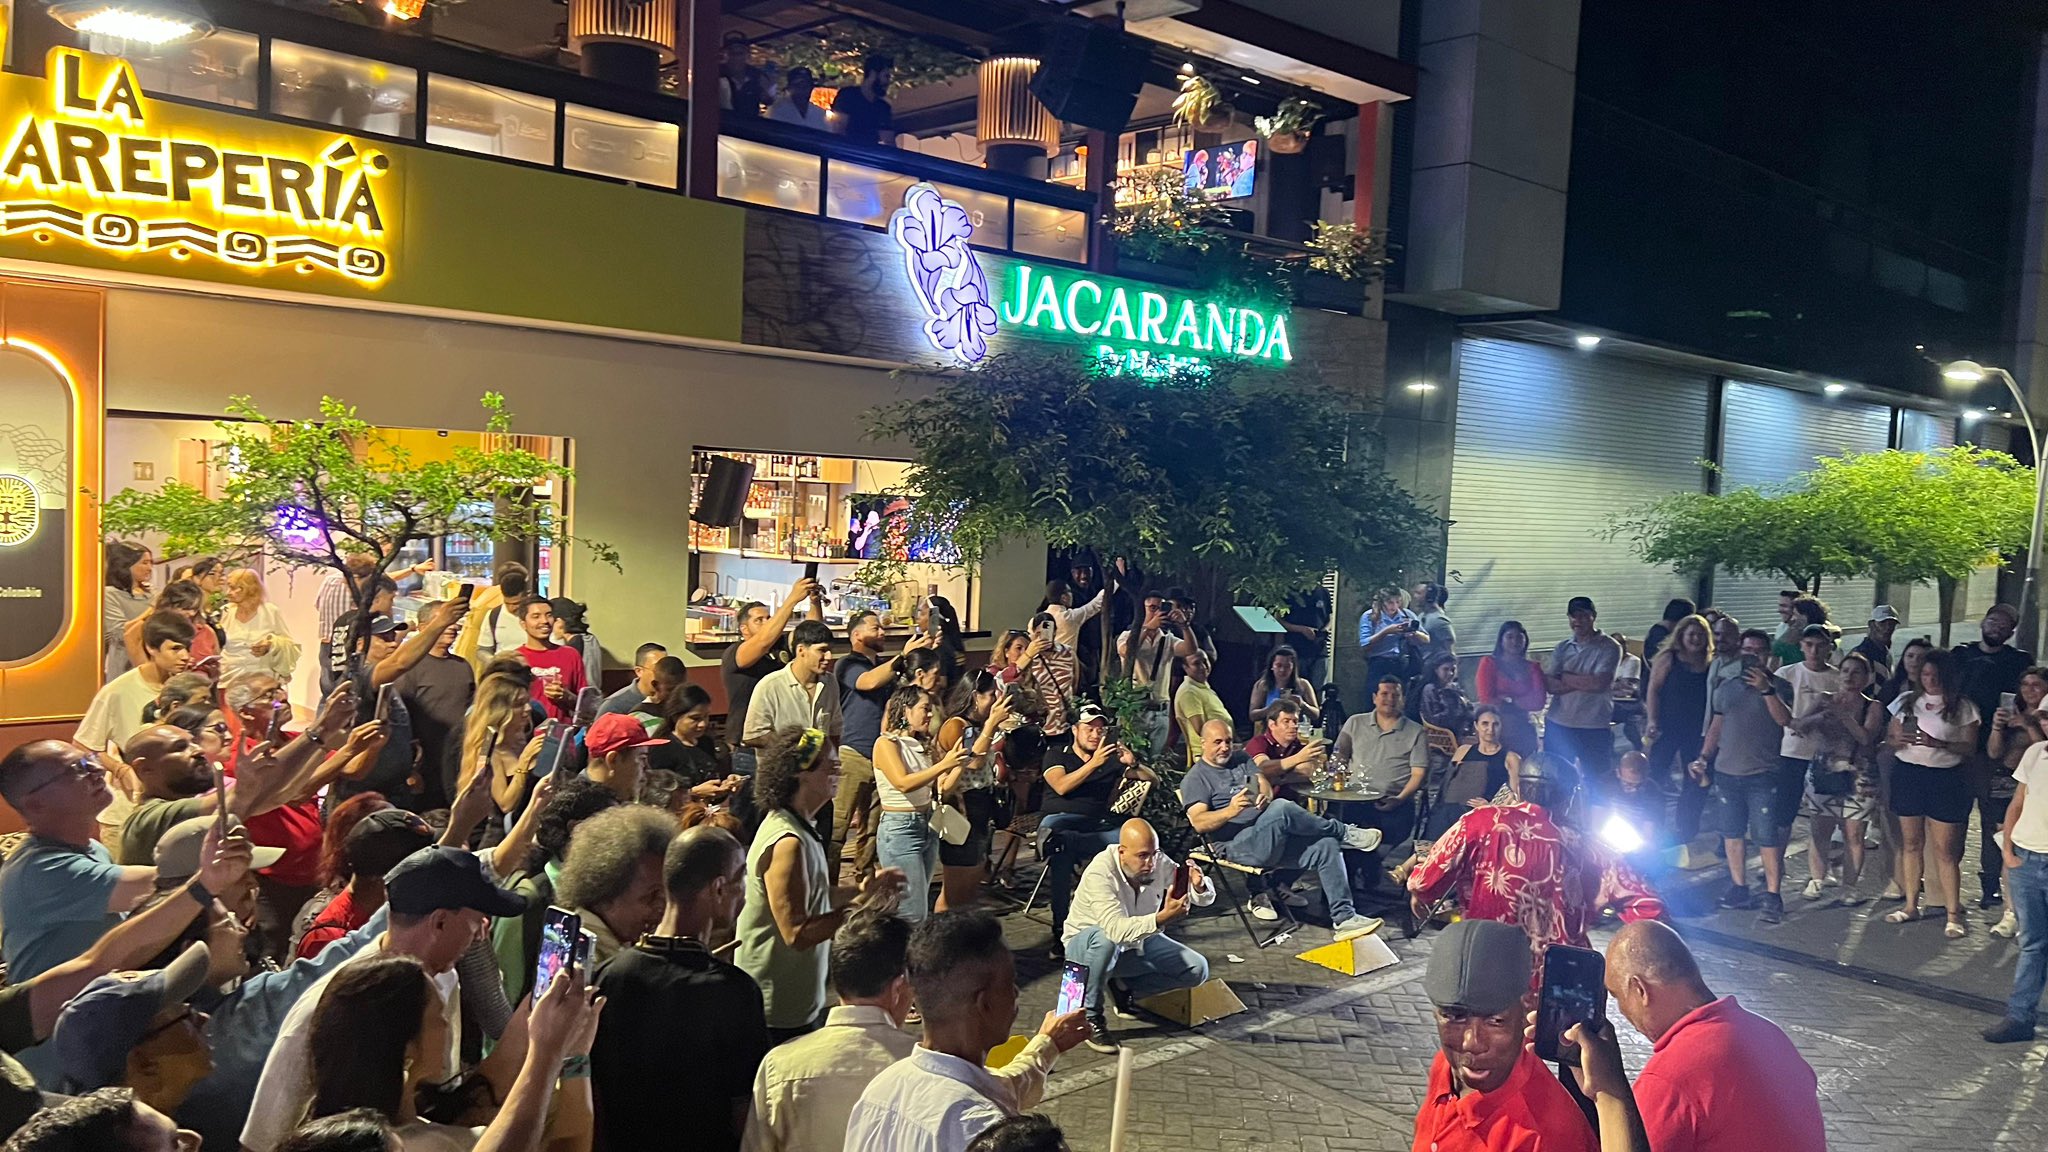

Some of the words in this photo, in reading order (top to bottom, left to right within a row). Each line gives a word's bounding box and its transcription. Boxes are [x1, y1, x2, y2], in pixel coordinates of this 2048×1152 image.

[63, 53, 144, 120] LA
[3, 117, 385, 231] AREPERÍA
[1001, 265, 1293, 361] JACARANDA
